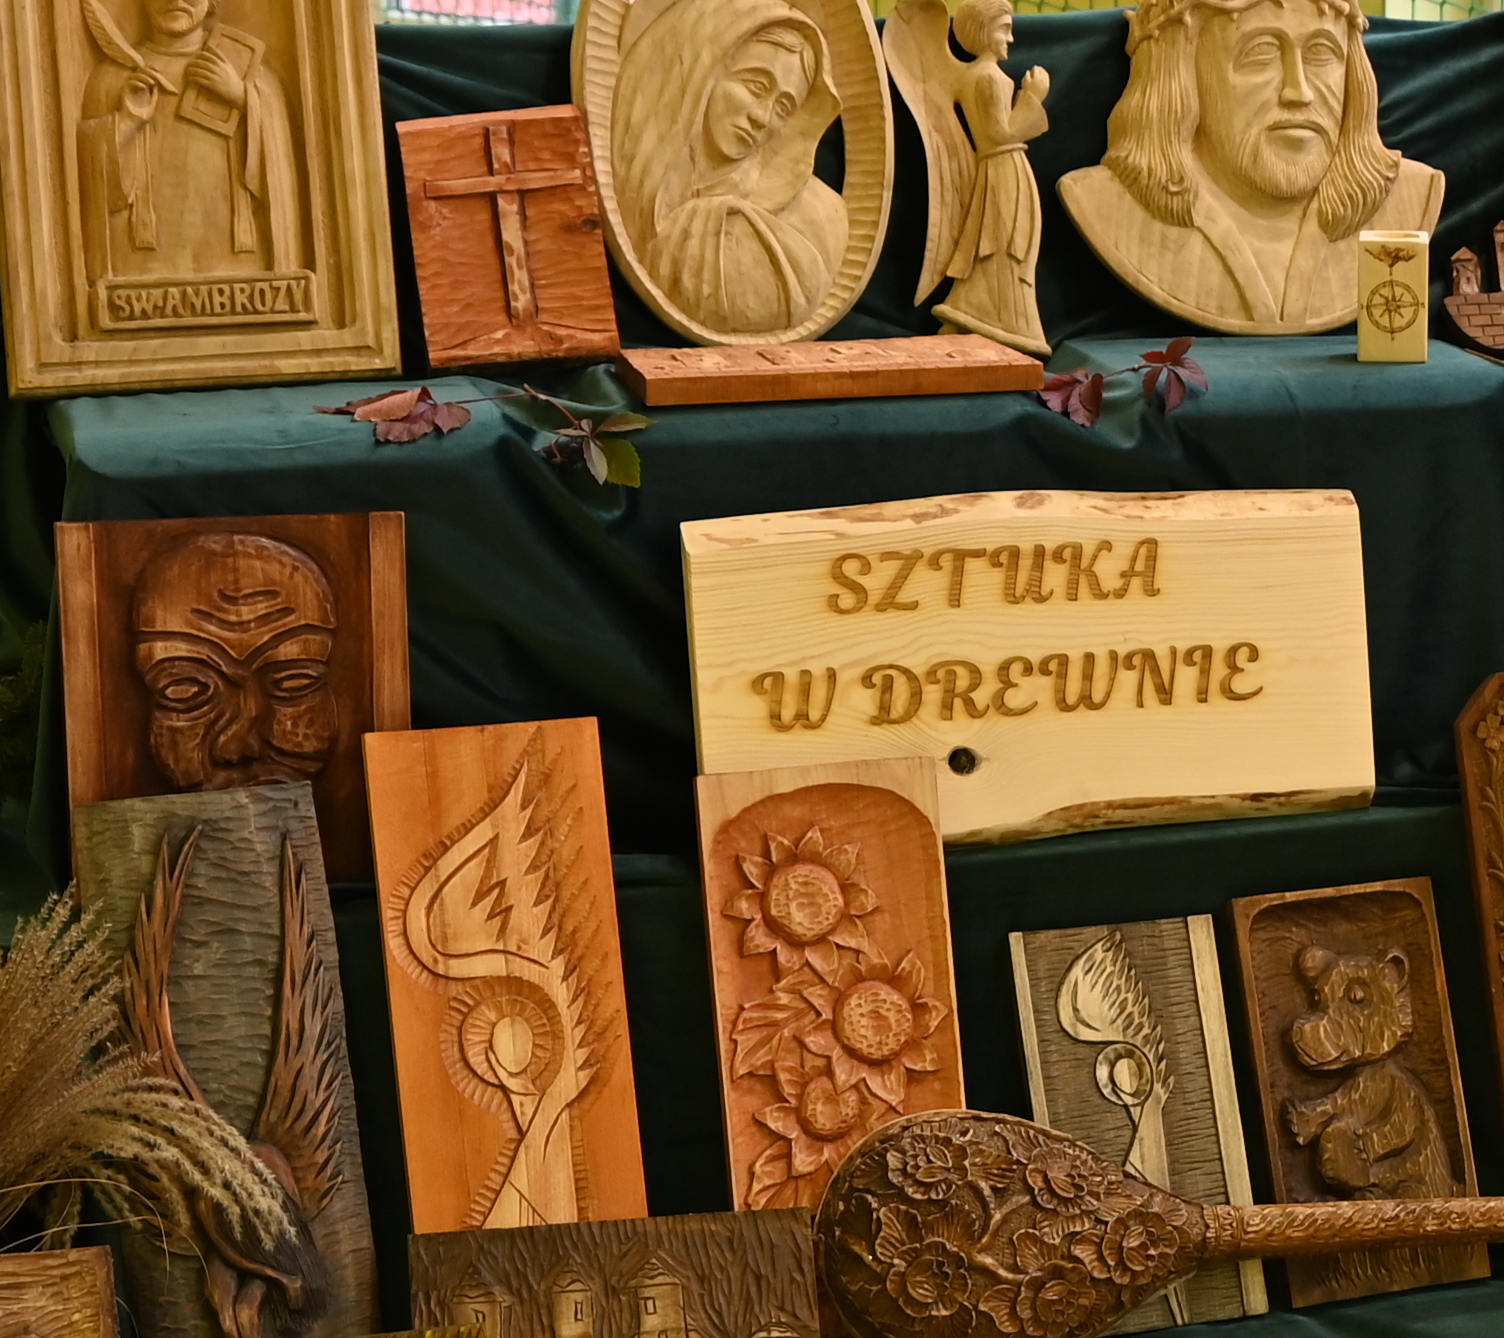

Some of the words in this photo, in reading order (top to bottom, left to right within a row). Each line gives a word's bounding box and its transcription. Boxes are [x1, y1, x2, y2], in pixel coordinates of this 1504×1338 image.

[827, 537, 1161, 615] SZTUKA
[751, 666, 837, 733] W
[861, 641, 1264, 726] DREWNIE
